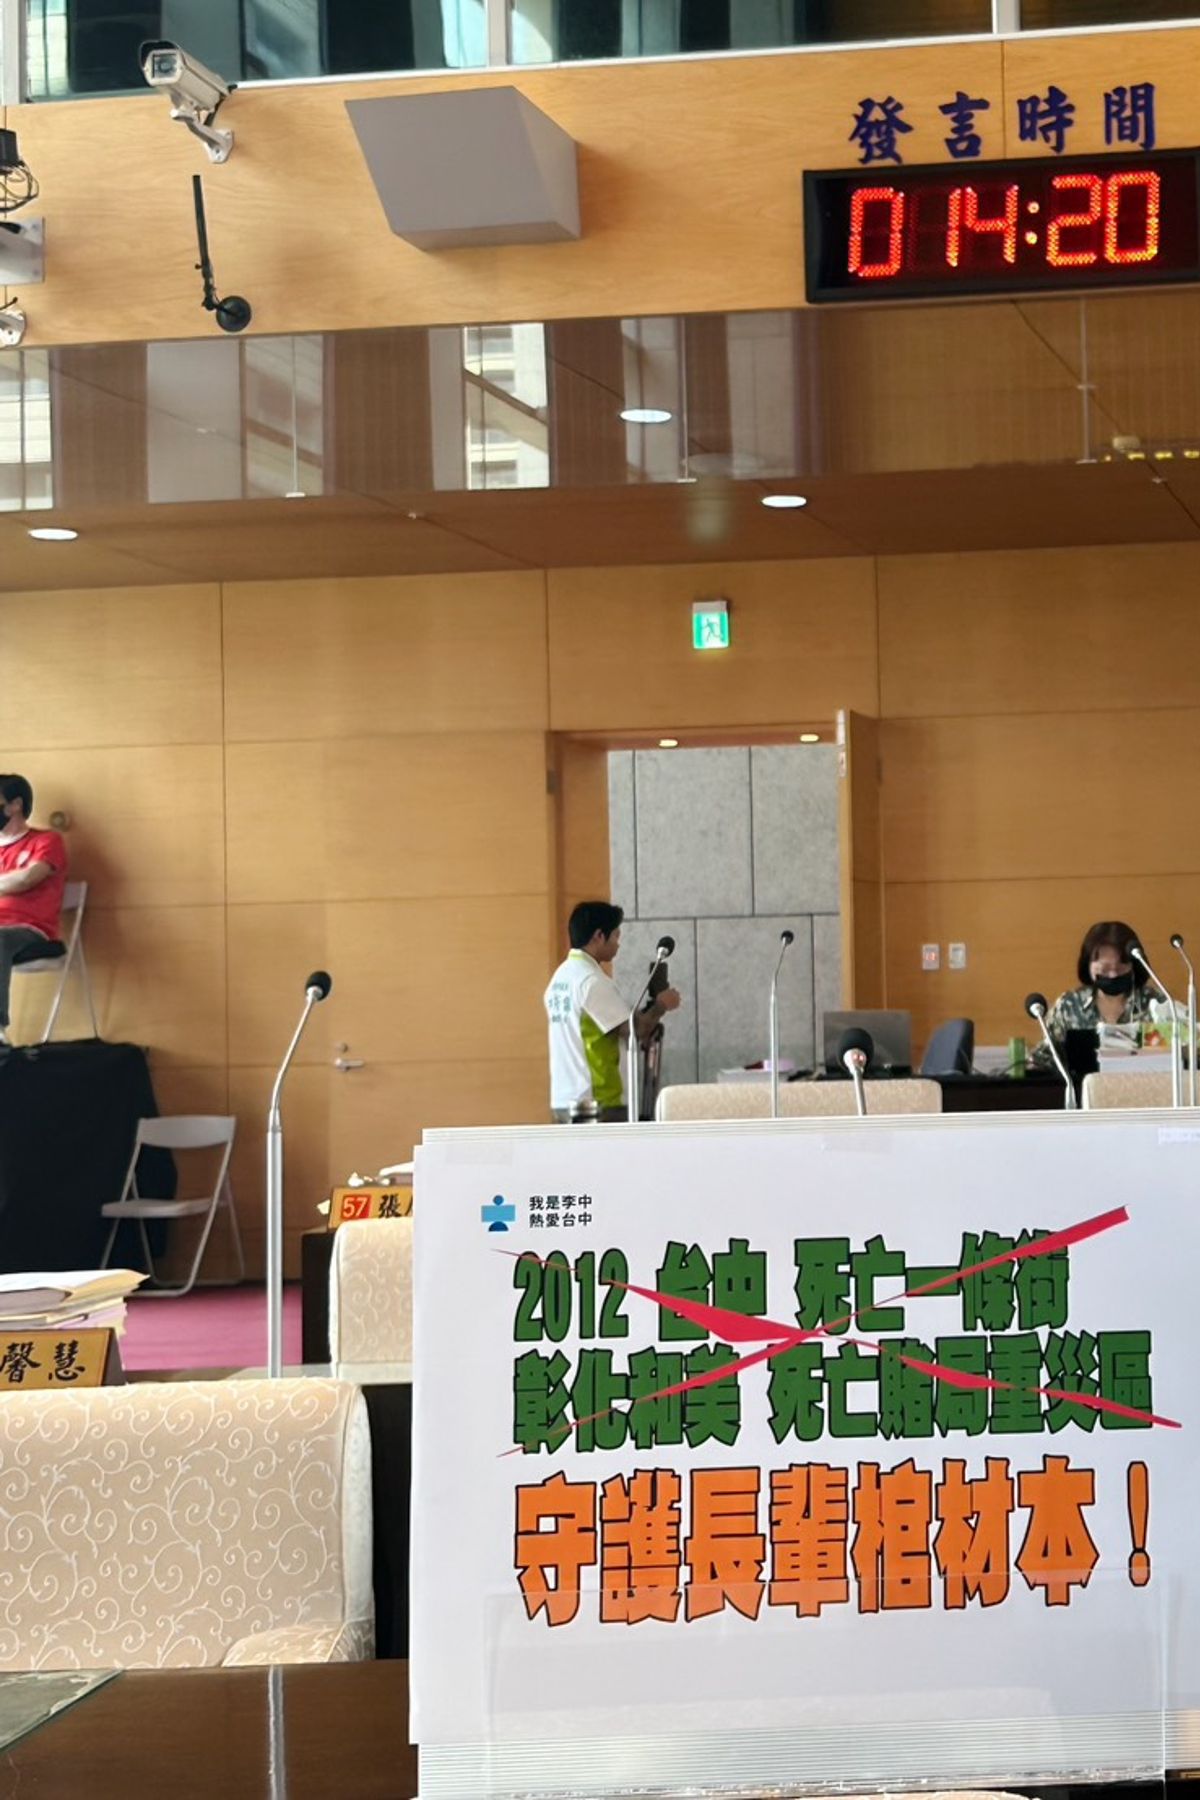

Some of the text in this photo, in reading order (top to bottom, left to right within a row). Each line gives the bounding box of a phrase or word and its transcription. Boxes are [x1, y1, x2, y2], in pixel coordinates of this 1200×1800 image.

[848, 82, 1157, 165] 發言時間
[342, 1194, 413, 1219] 57 張
[529, 1194, 592, 1211] 我是李中
[529, 1212, 592, 1228] 熱愛台中
[513, 1249, 630, 1342] 2012
[656, 1238, 768, 1342] 台中
[513, 1330, 1153, 1454] 彰化和美 死亡賭局重災區
[513, 1454, 1151, 1626] 守護長輩棺材本！
